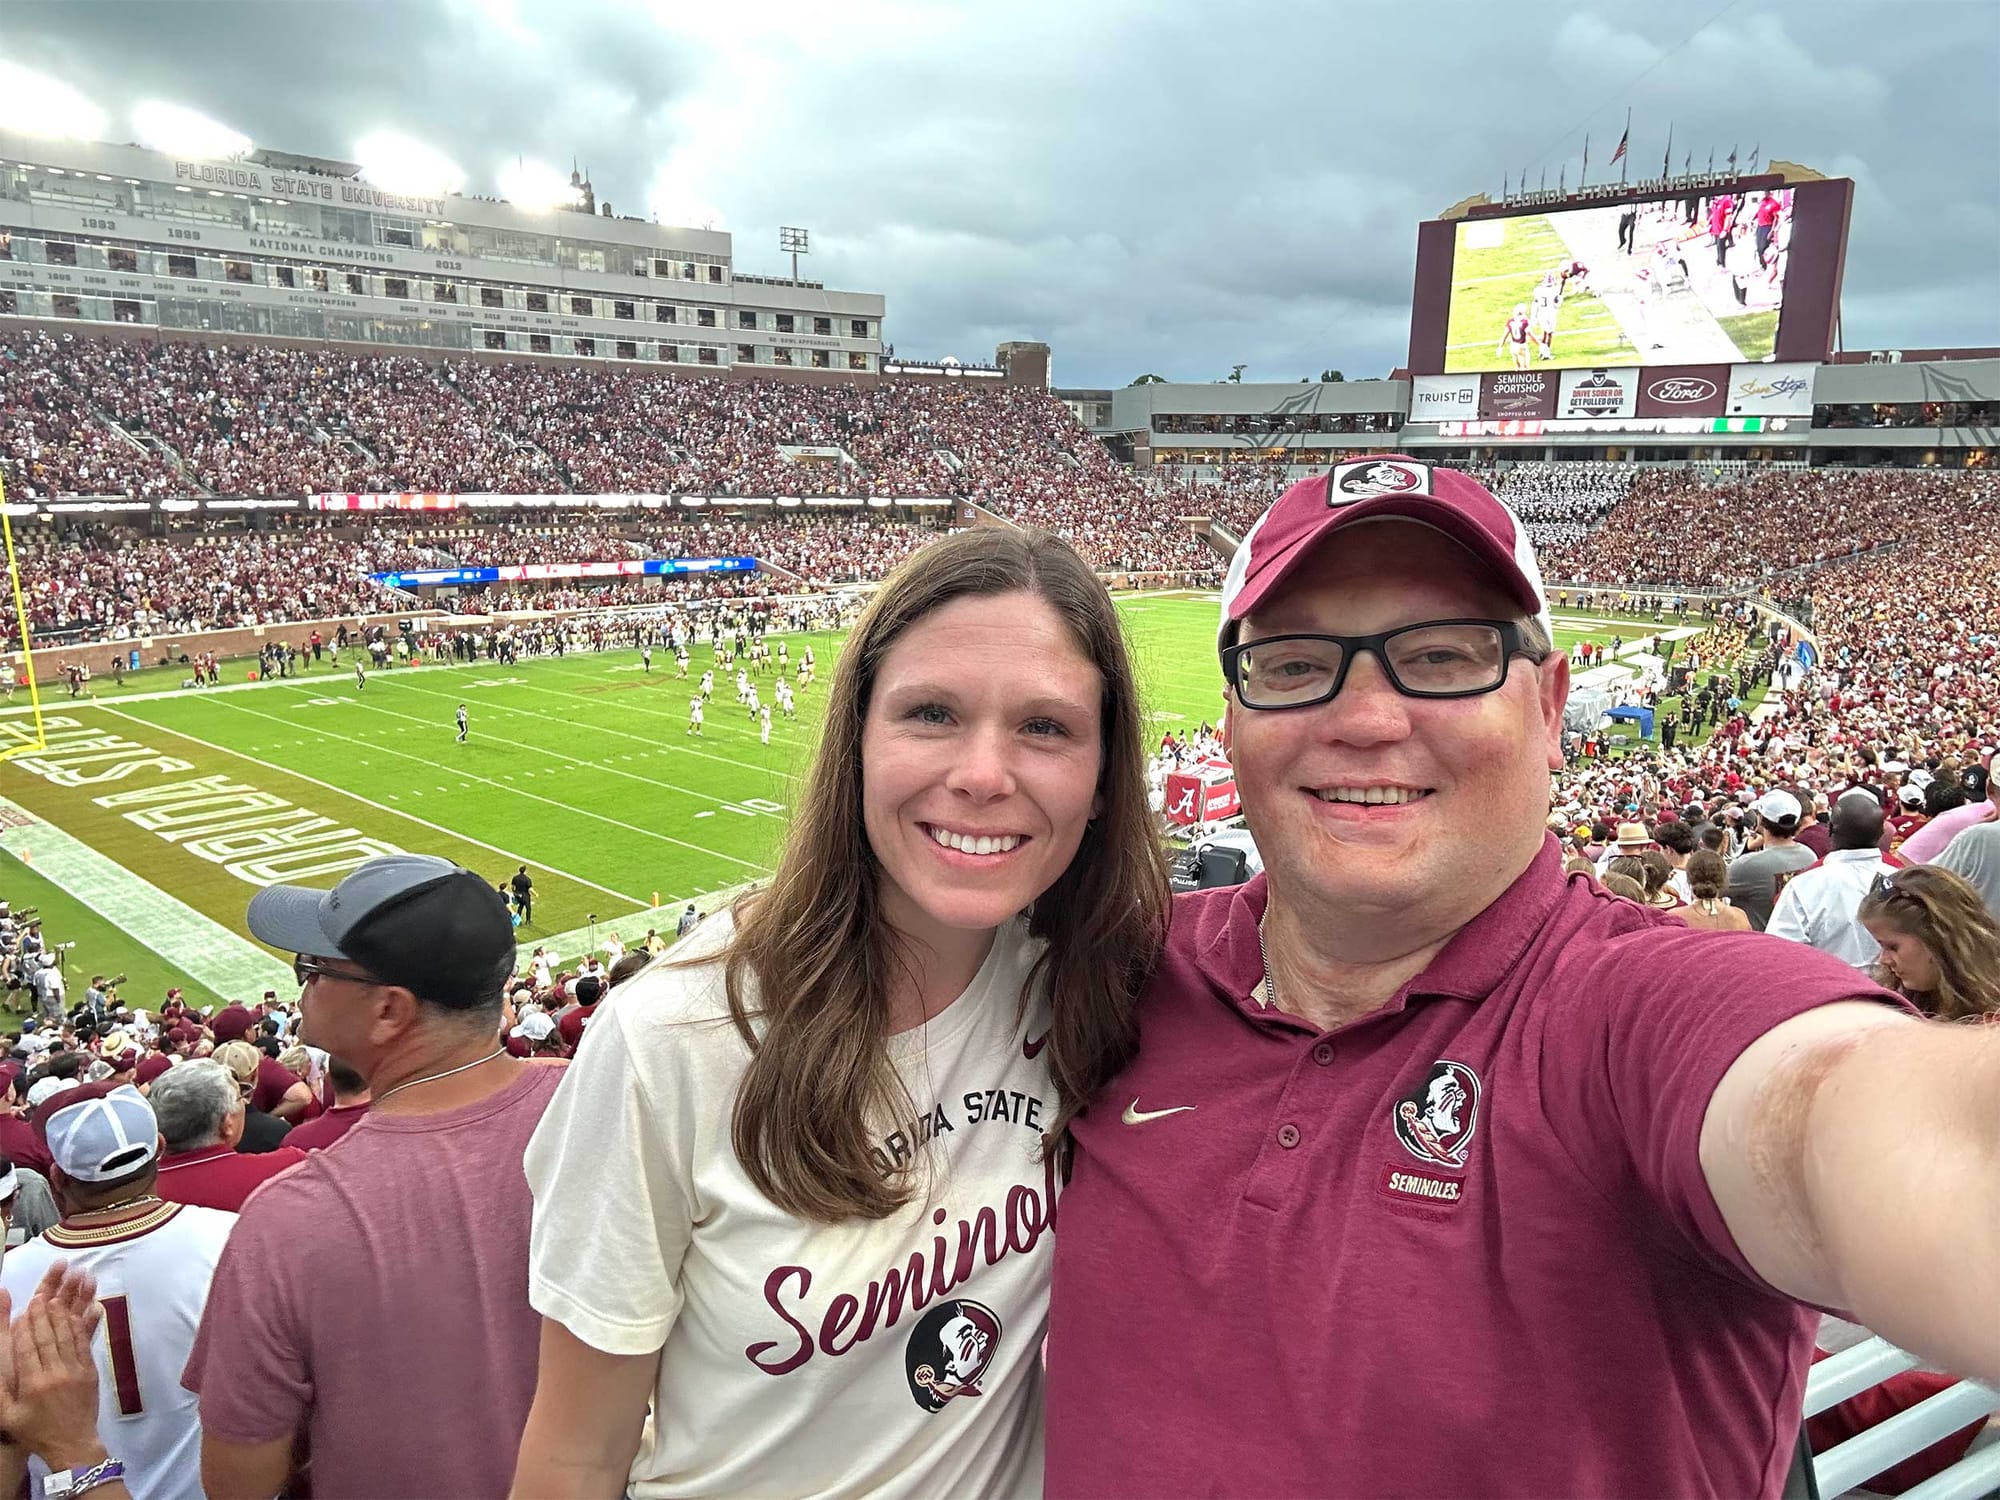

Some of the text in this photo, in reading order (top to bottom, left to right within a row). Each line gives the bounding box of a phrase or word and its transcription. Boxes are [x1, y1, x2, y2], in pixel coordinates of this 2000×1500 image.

[175, 161, 446, 216] FLORIDA STATE UNIVERSITY
[1502, 169, 1743, 209] FLORIDA STATE UNIVERSITY
[250, 238, 314, 254] NATIONAL
[319, 246, 394, 263] CHAMPIONS
[1493, 383, 1545, 394] SPORTSHOP
[1497, 373, 1543, 384] SEMINOLE
[1659, 381, 1705, 400] Ford
[1418, 392, 1457, 403] TRUIST
[1570, 397, 1624, 406] GET PULLED OVER
[1572, 389, 1623, 398] DRIVE SOBER OR
[1168, 787, 1195, 818] A
[91, 774, 408, 887] ORIDA
[1389, 1172, 1459, 1200] SEMINOLES
[745, 1133, 1057, 1376] Seminol
[98, 1294, 144, 1421] 1
